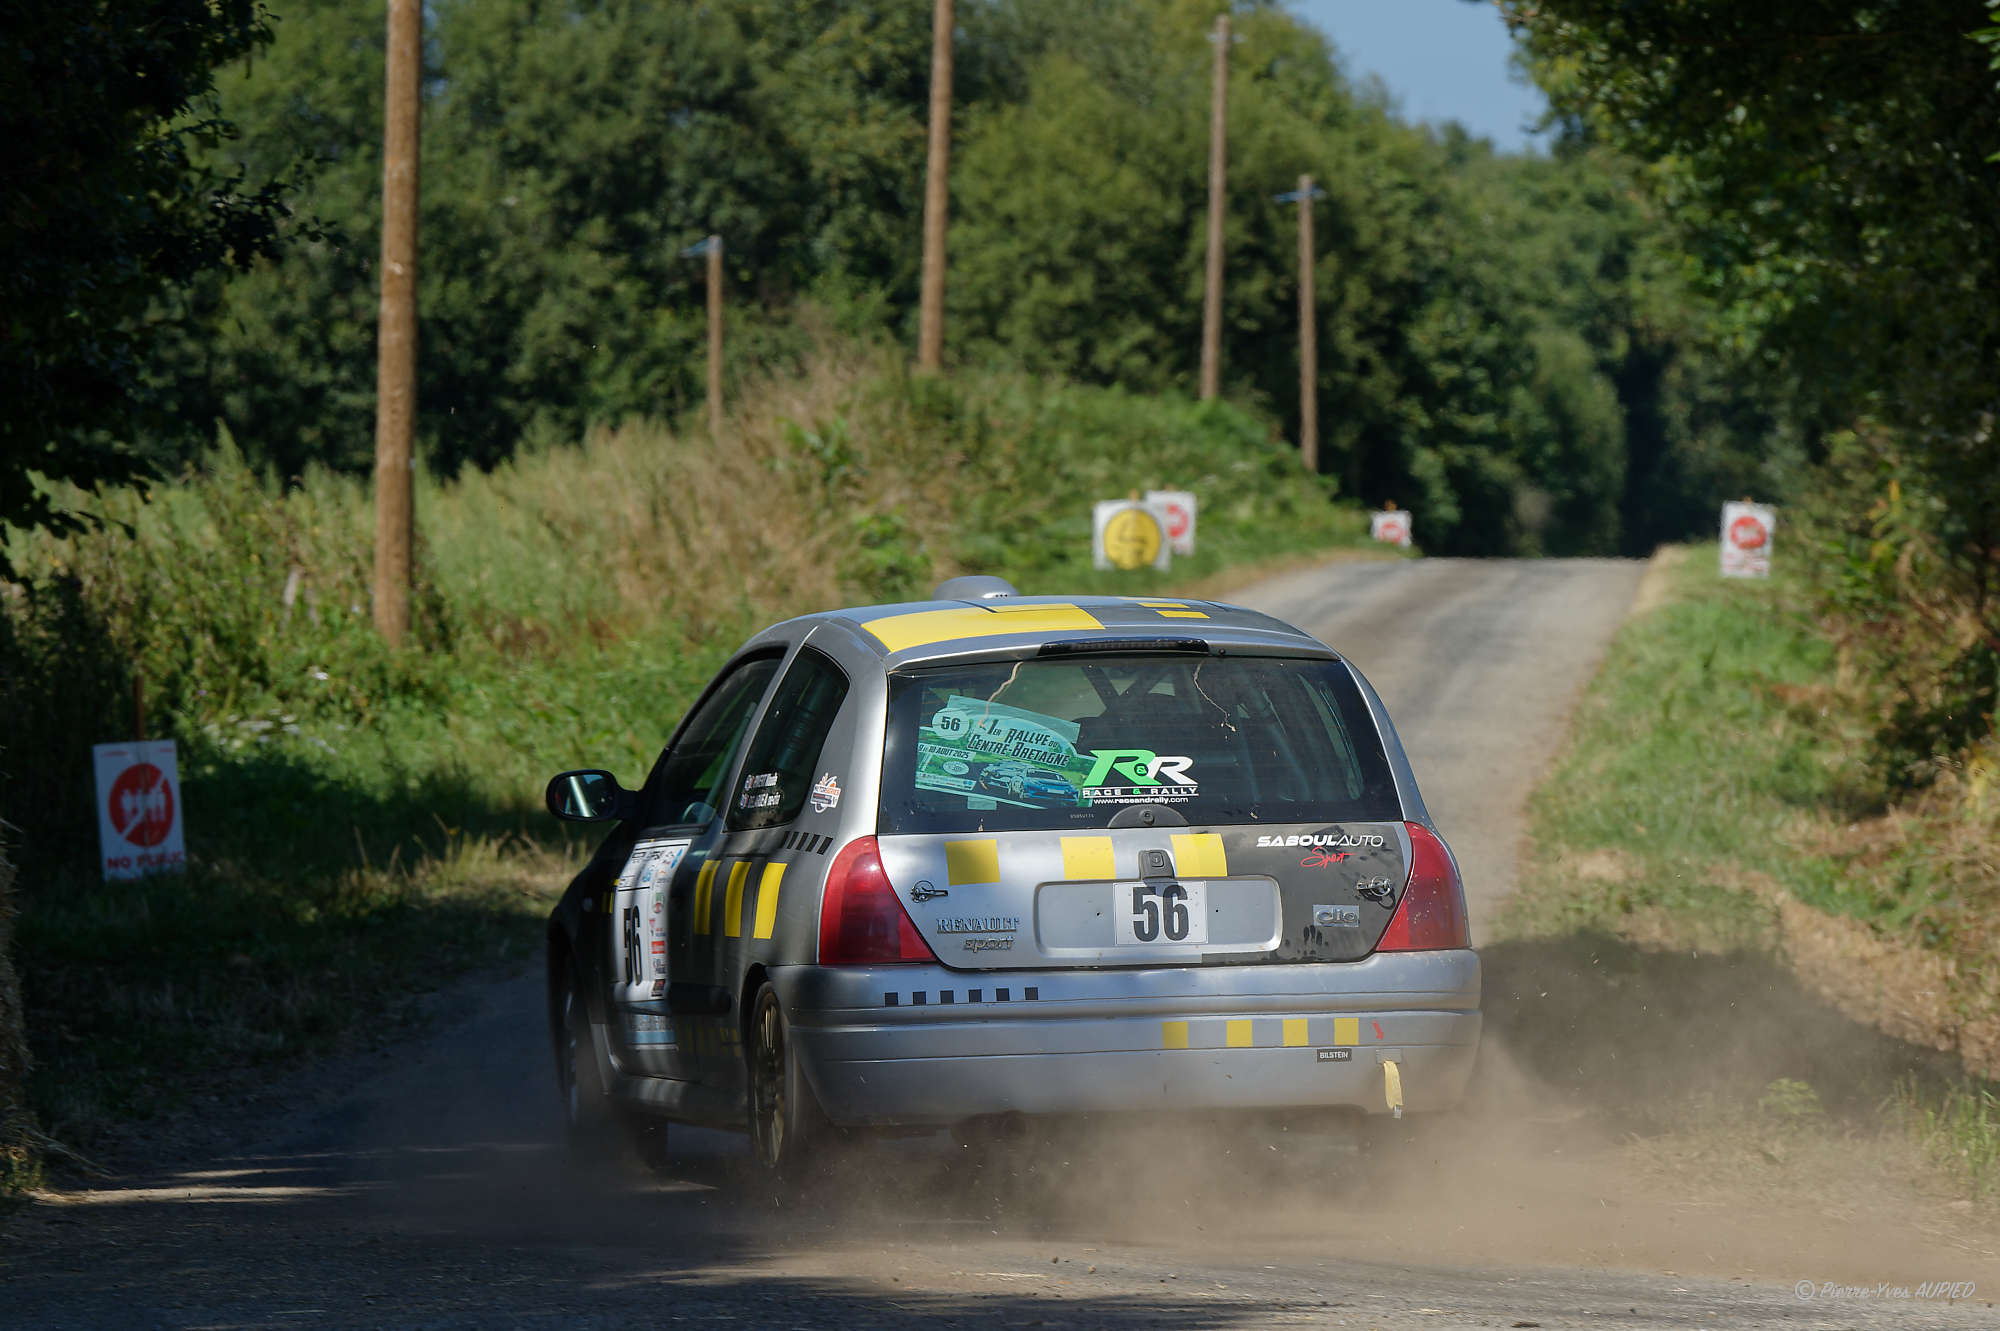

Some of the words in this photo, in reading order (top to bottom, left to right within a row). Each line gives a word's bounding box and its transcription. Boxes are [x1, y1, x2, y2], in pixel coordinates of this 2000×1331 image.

[940, 716, 960, 732] 56
[1004, 728, 1050, 746] RALLYE
[953, 750, 969, 760] 2025
[967, 733, 1070, 767] CENTRE-BRETAGNE
[1083, 788, 1122, 797] RACE
[1150, 786, 1198, 795] RALLY
[1093, 797, 1189, 805] www.raceandrally.com
[107, 856, 131, 870] NO
[1300, 845, 1358, 870] Sport
[1132, 884, 1190, 943] 56
[936, 916, 1019, 932] RENAULT
[623, 905, 643, 987] 56
[963, 935, 1015, 954] sport
[1319, 1050, 1349, 1060] BILSTEIN
